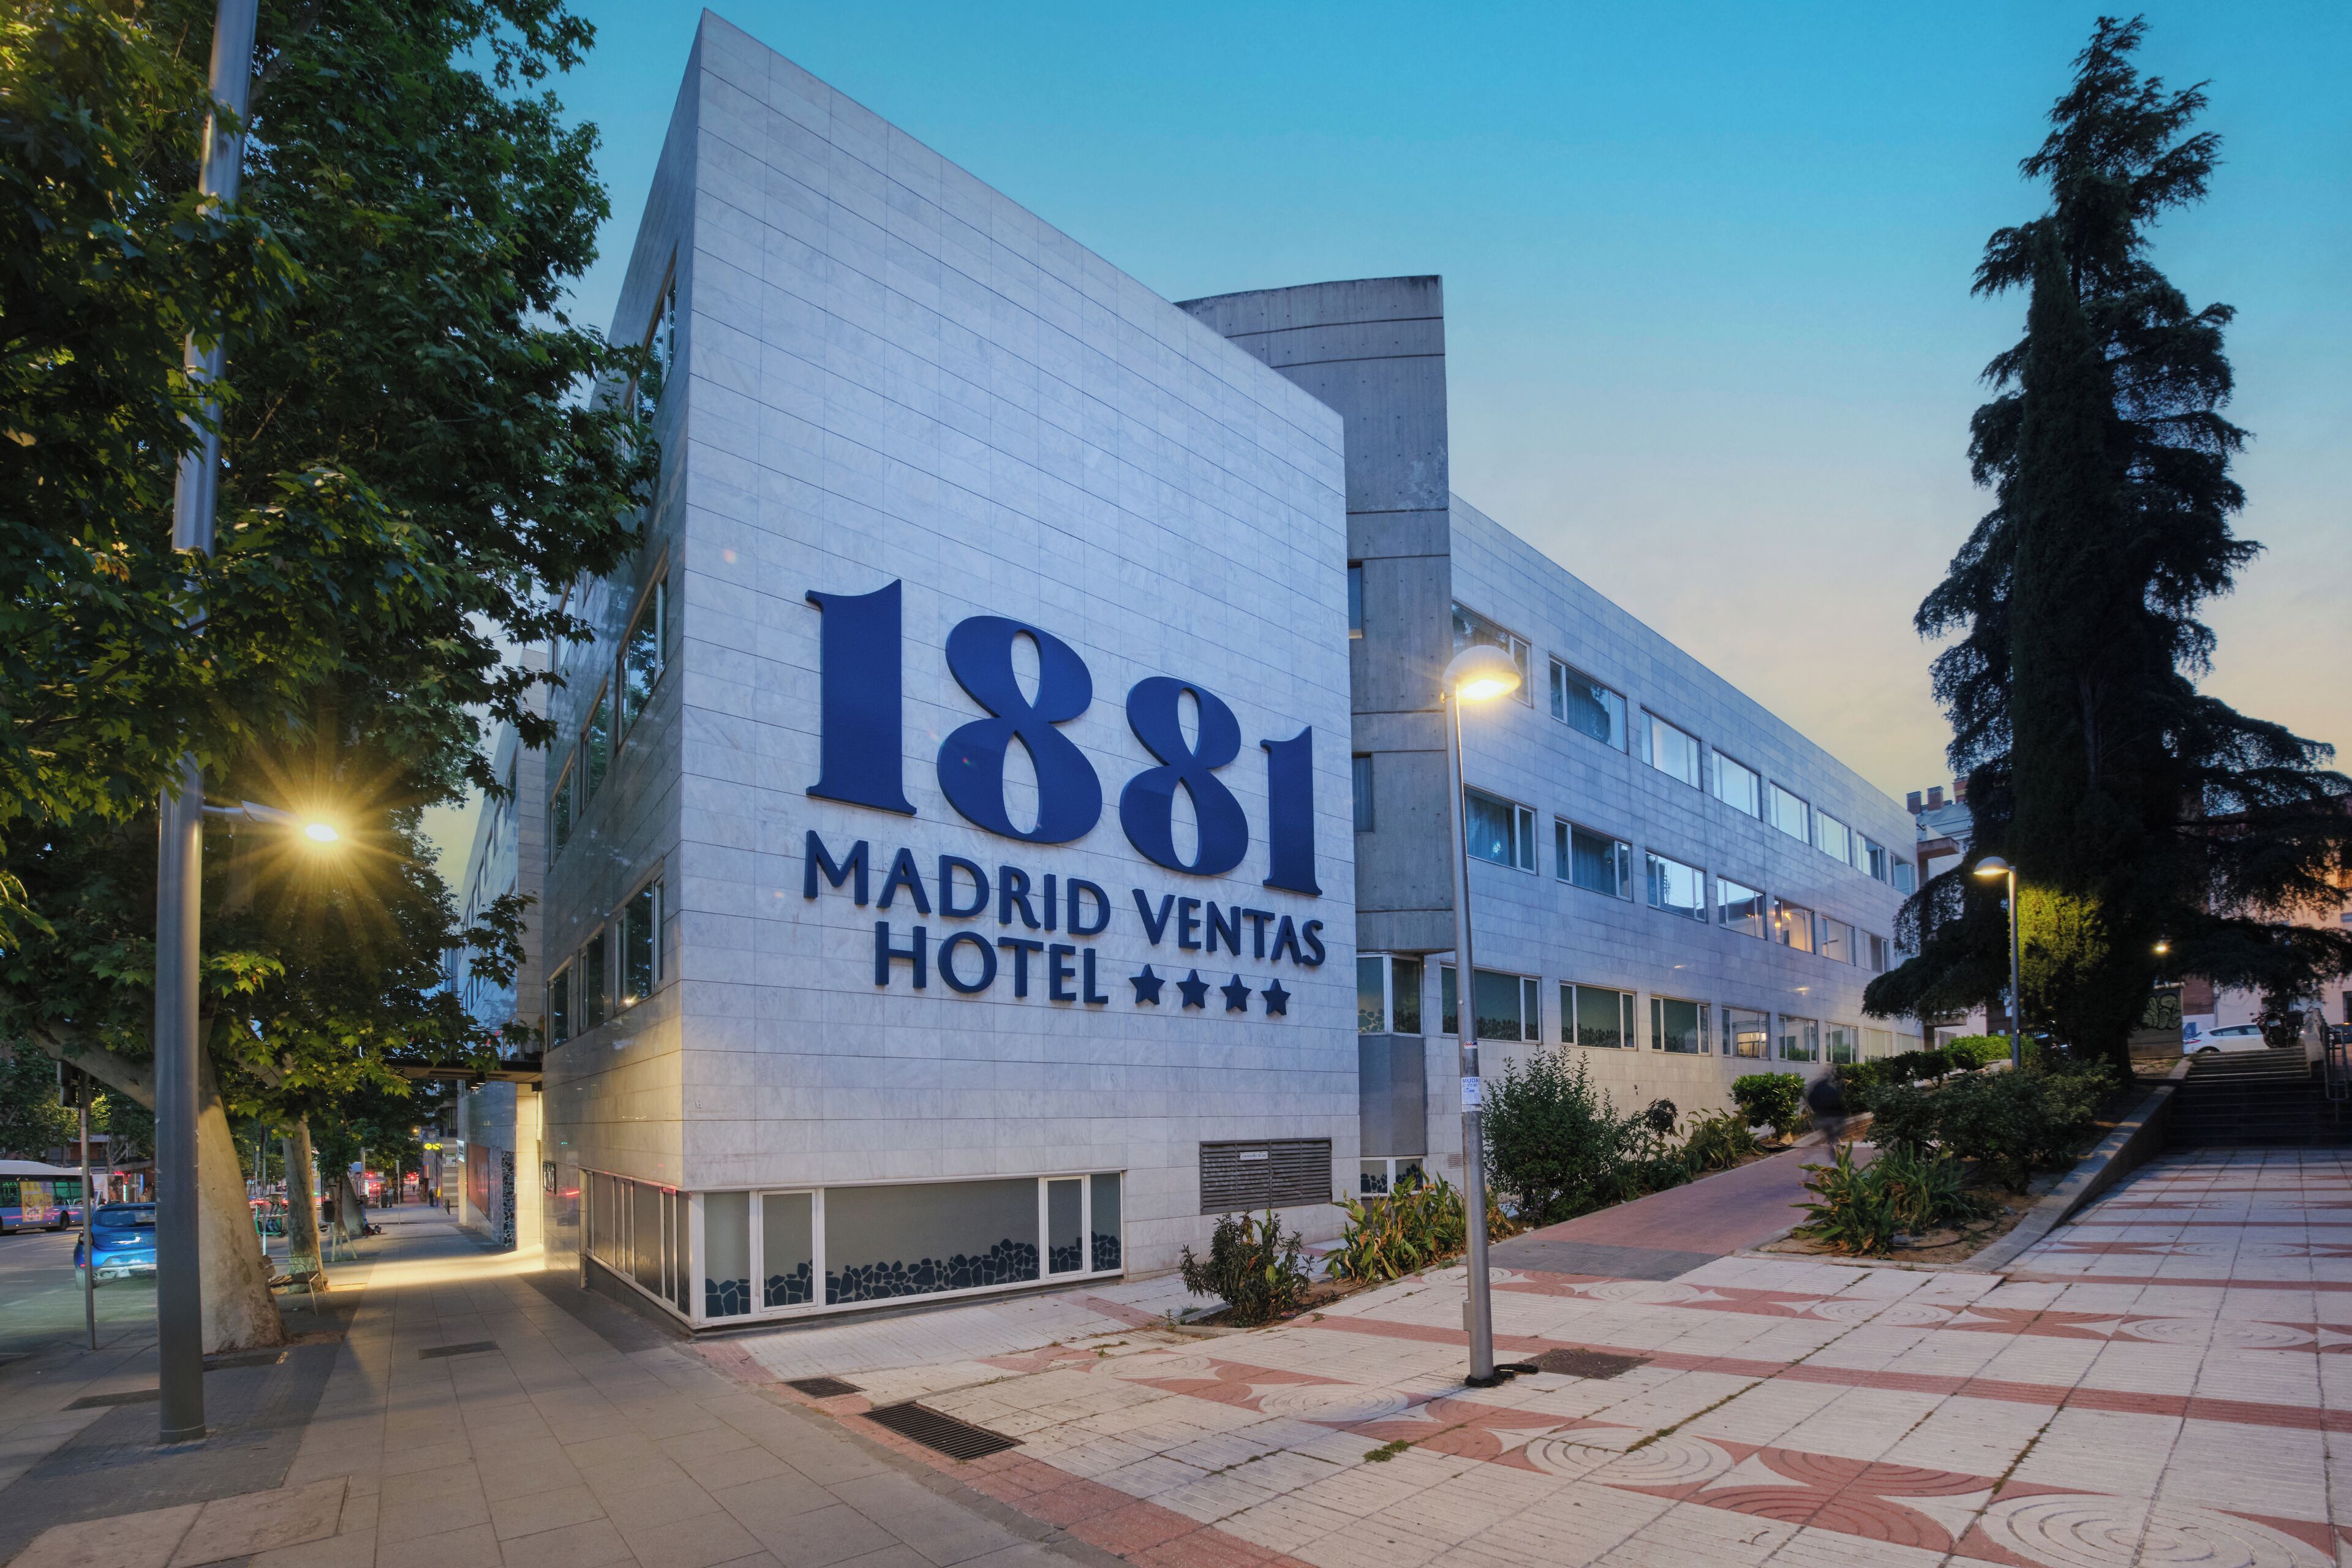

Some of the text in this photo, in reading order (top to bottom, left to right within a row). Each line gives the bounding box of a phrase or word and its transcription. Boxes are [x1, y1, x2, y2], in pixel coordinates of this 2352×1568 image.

[805, 578, 1323, 897] 1881
[802, 829, 1326, 968] MADRID VENTAS
[873, 920, 1109, 1005] HOTEL
